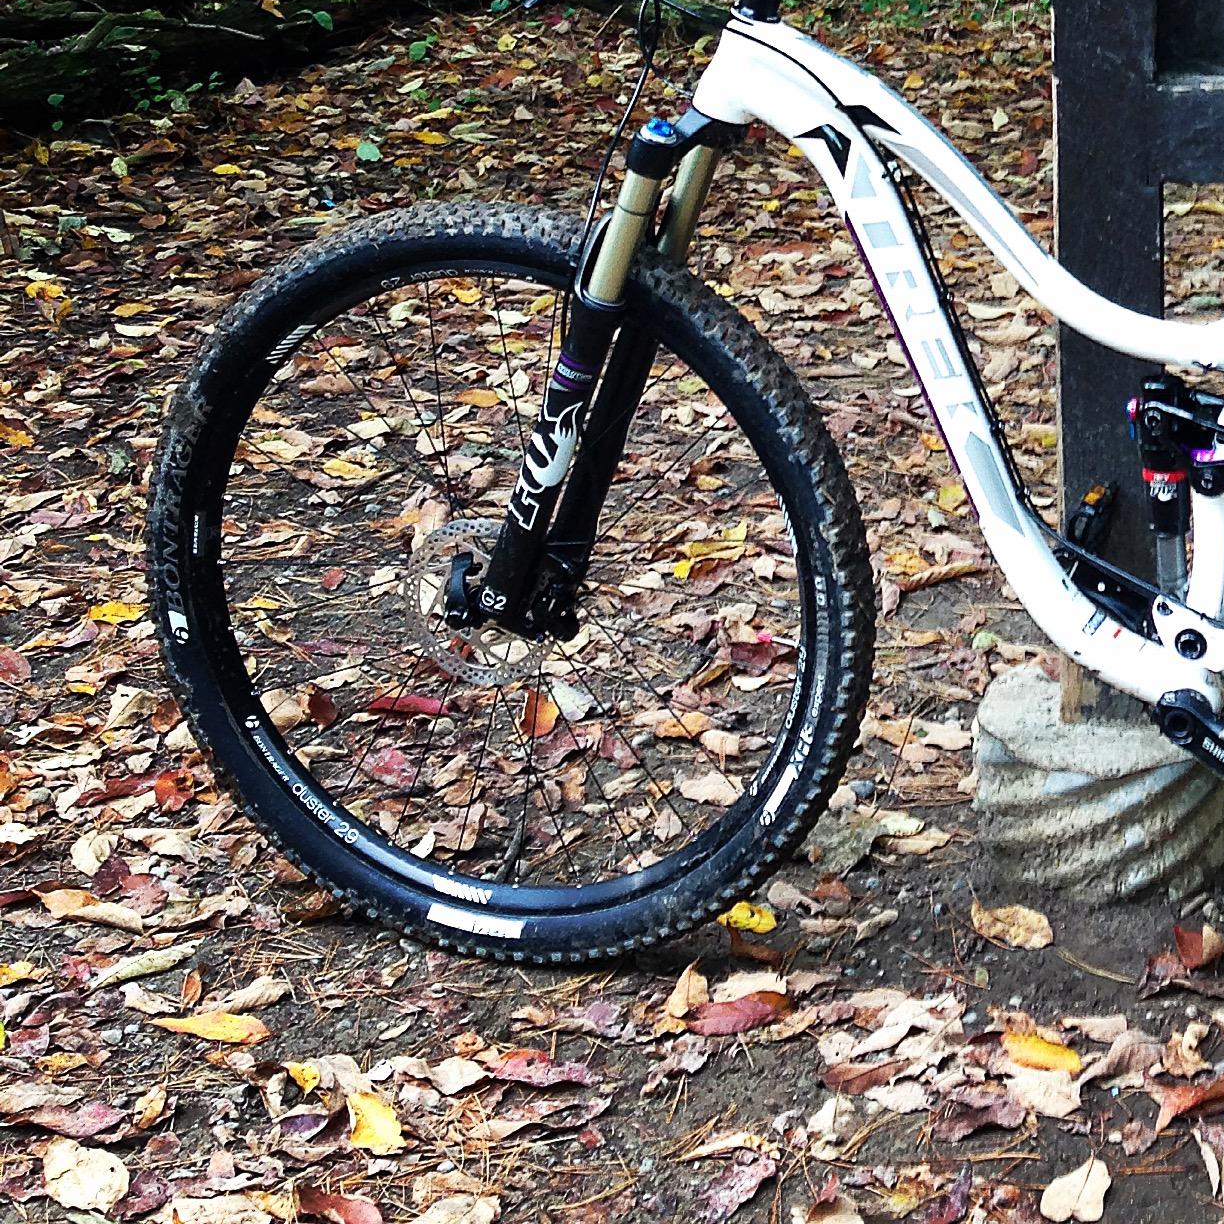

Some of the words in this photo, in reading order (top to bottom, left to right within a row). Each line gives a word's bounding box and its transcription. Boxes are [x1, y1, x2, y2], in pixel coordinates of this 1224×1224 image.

[850, 173, 988, 444] TREK
[481, 589, 508, 612] G2
[292, 782, 335, 824] duster
[334, 821, 360, 844] 29
